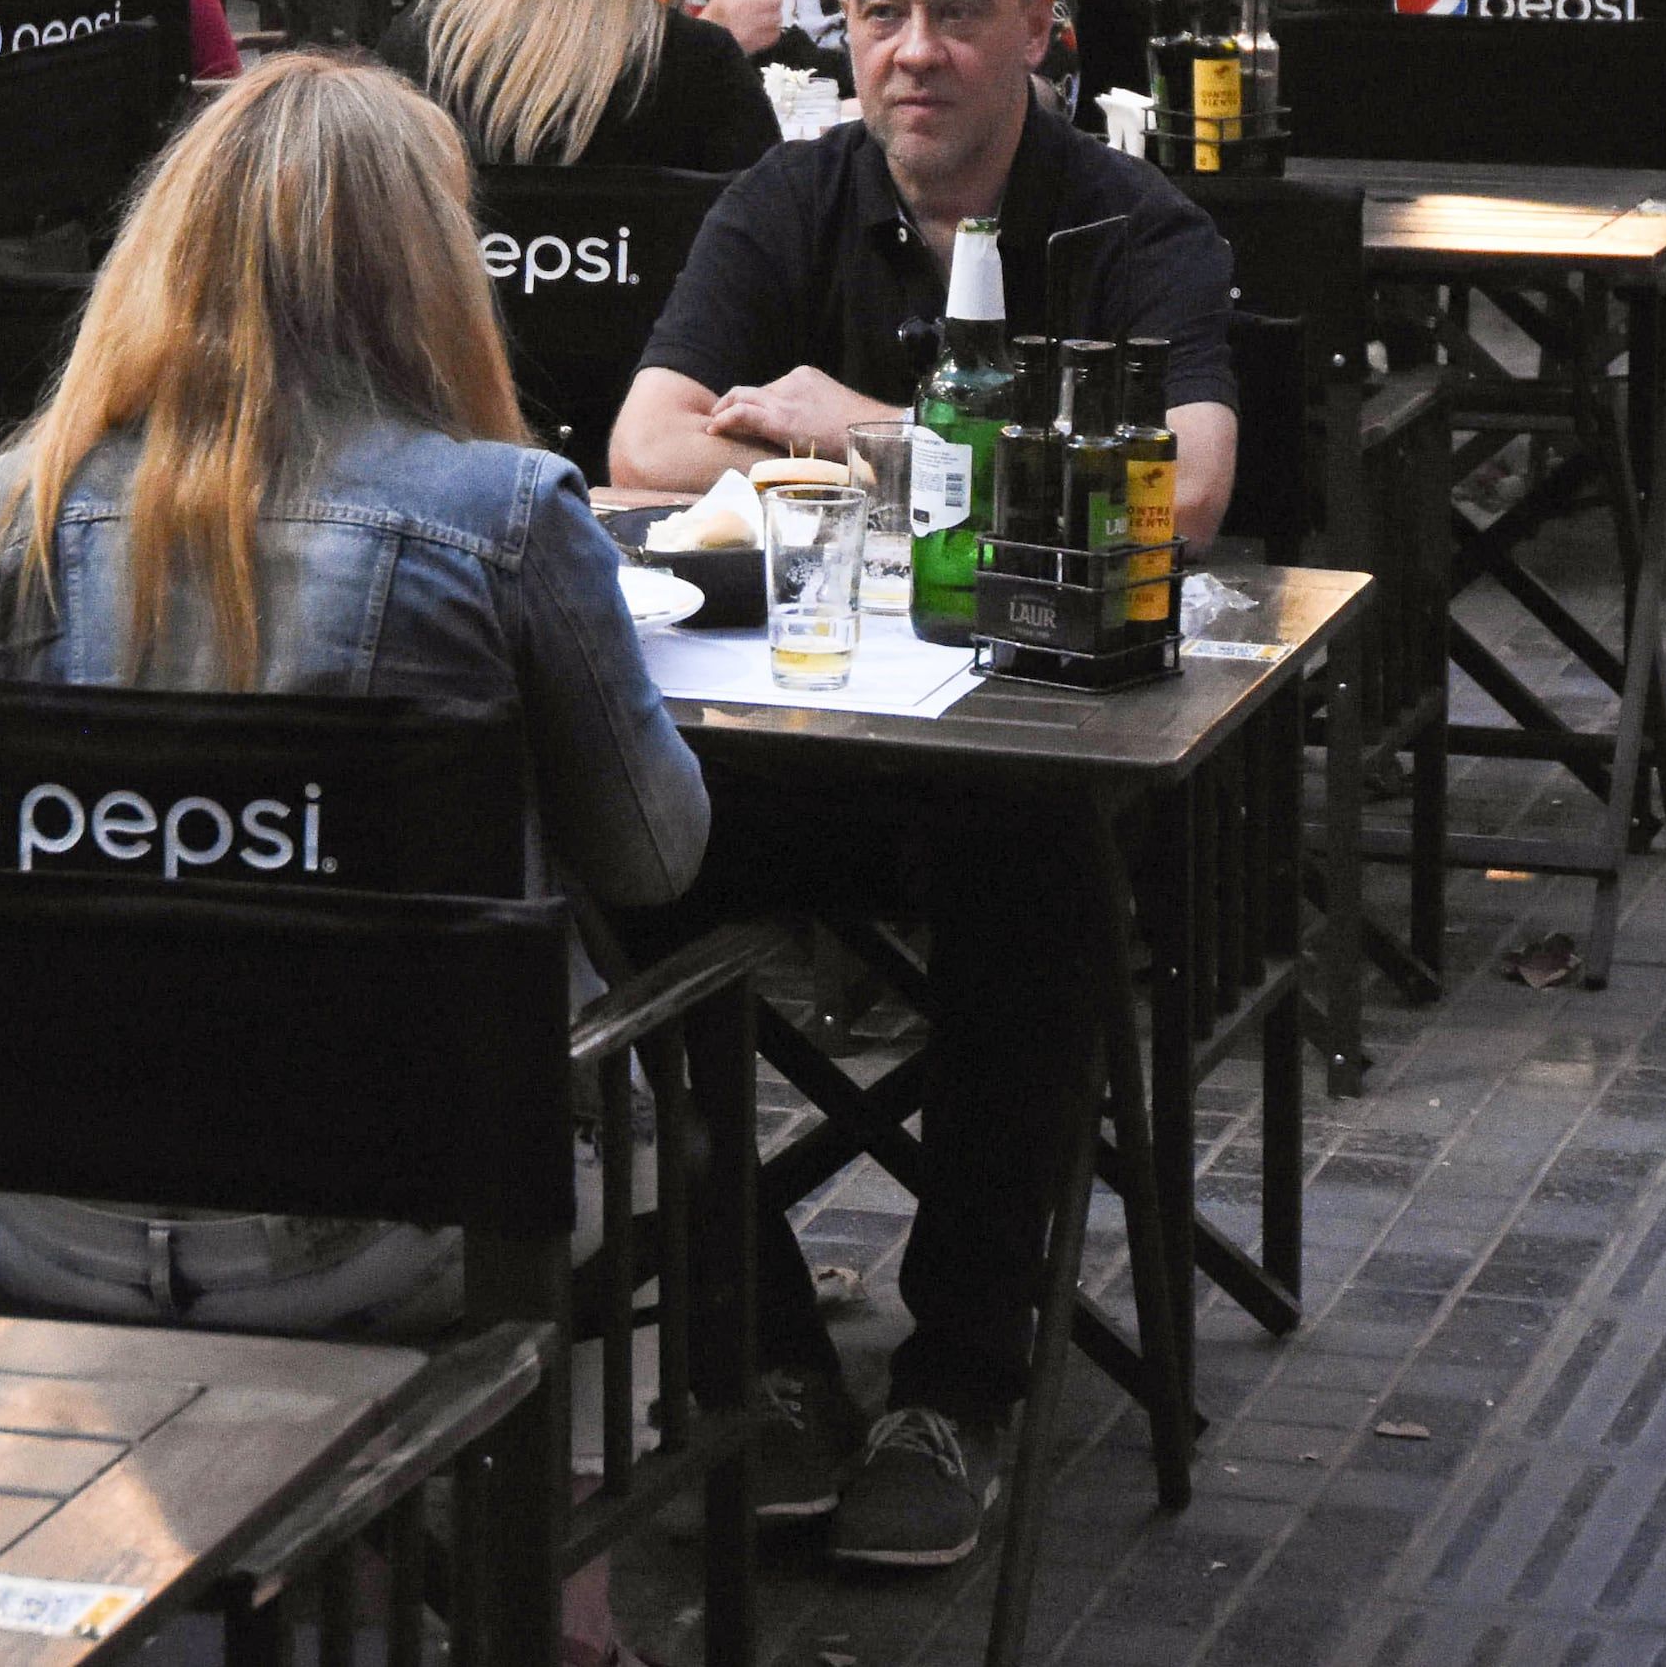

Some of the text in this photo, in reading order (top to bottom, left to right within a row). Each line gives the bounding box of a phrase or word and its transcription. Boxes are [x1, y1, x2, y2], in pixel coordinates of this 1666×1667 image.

[481, 225, 637, 295] epsi
[1009, 601, 1057, 629] LAUR
[18, 782, 331, 879] pepsi
